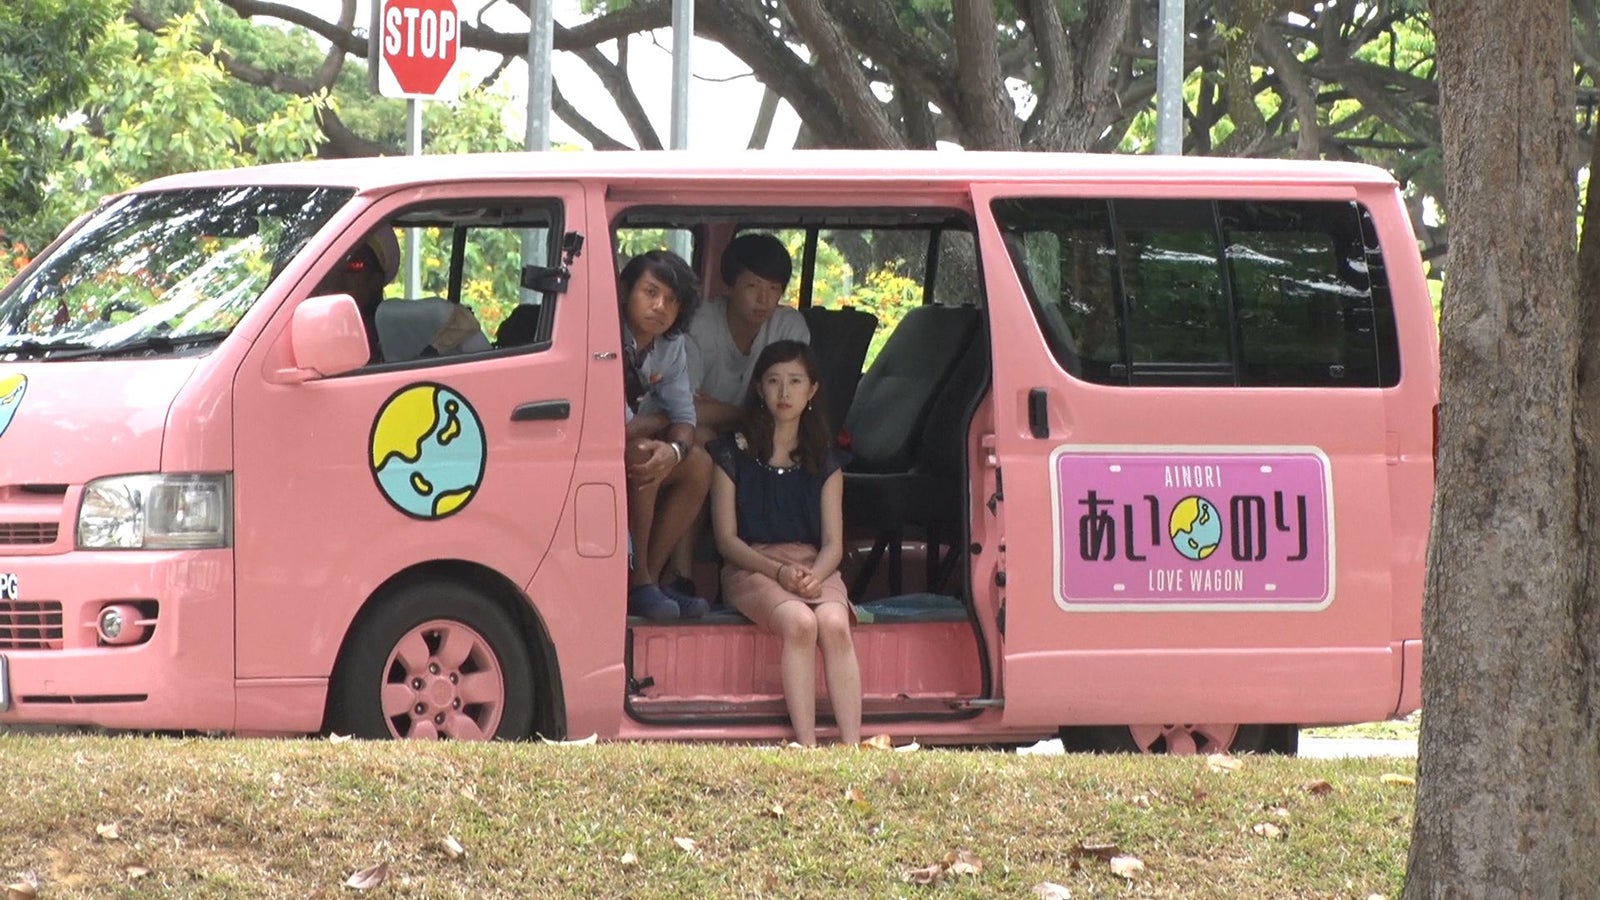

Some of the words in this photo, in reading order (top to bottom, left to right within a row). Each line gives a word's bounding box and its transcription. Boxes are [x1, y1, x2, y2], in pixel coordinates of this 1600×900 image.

[385, 6, 455, 60] STOP
[1165, 465, 1222, 488] AINORI
[1149, 569, 1183, 592] LOVE
[1190, 569, 1244, 592] WAGON
